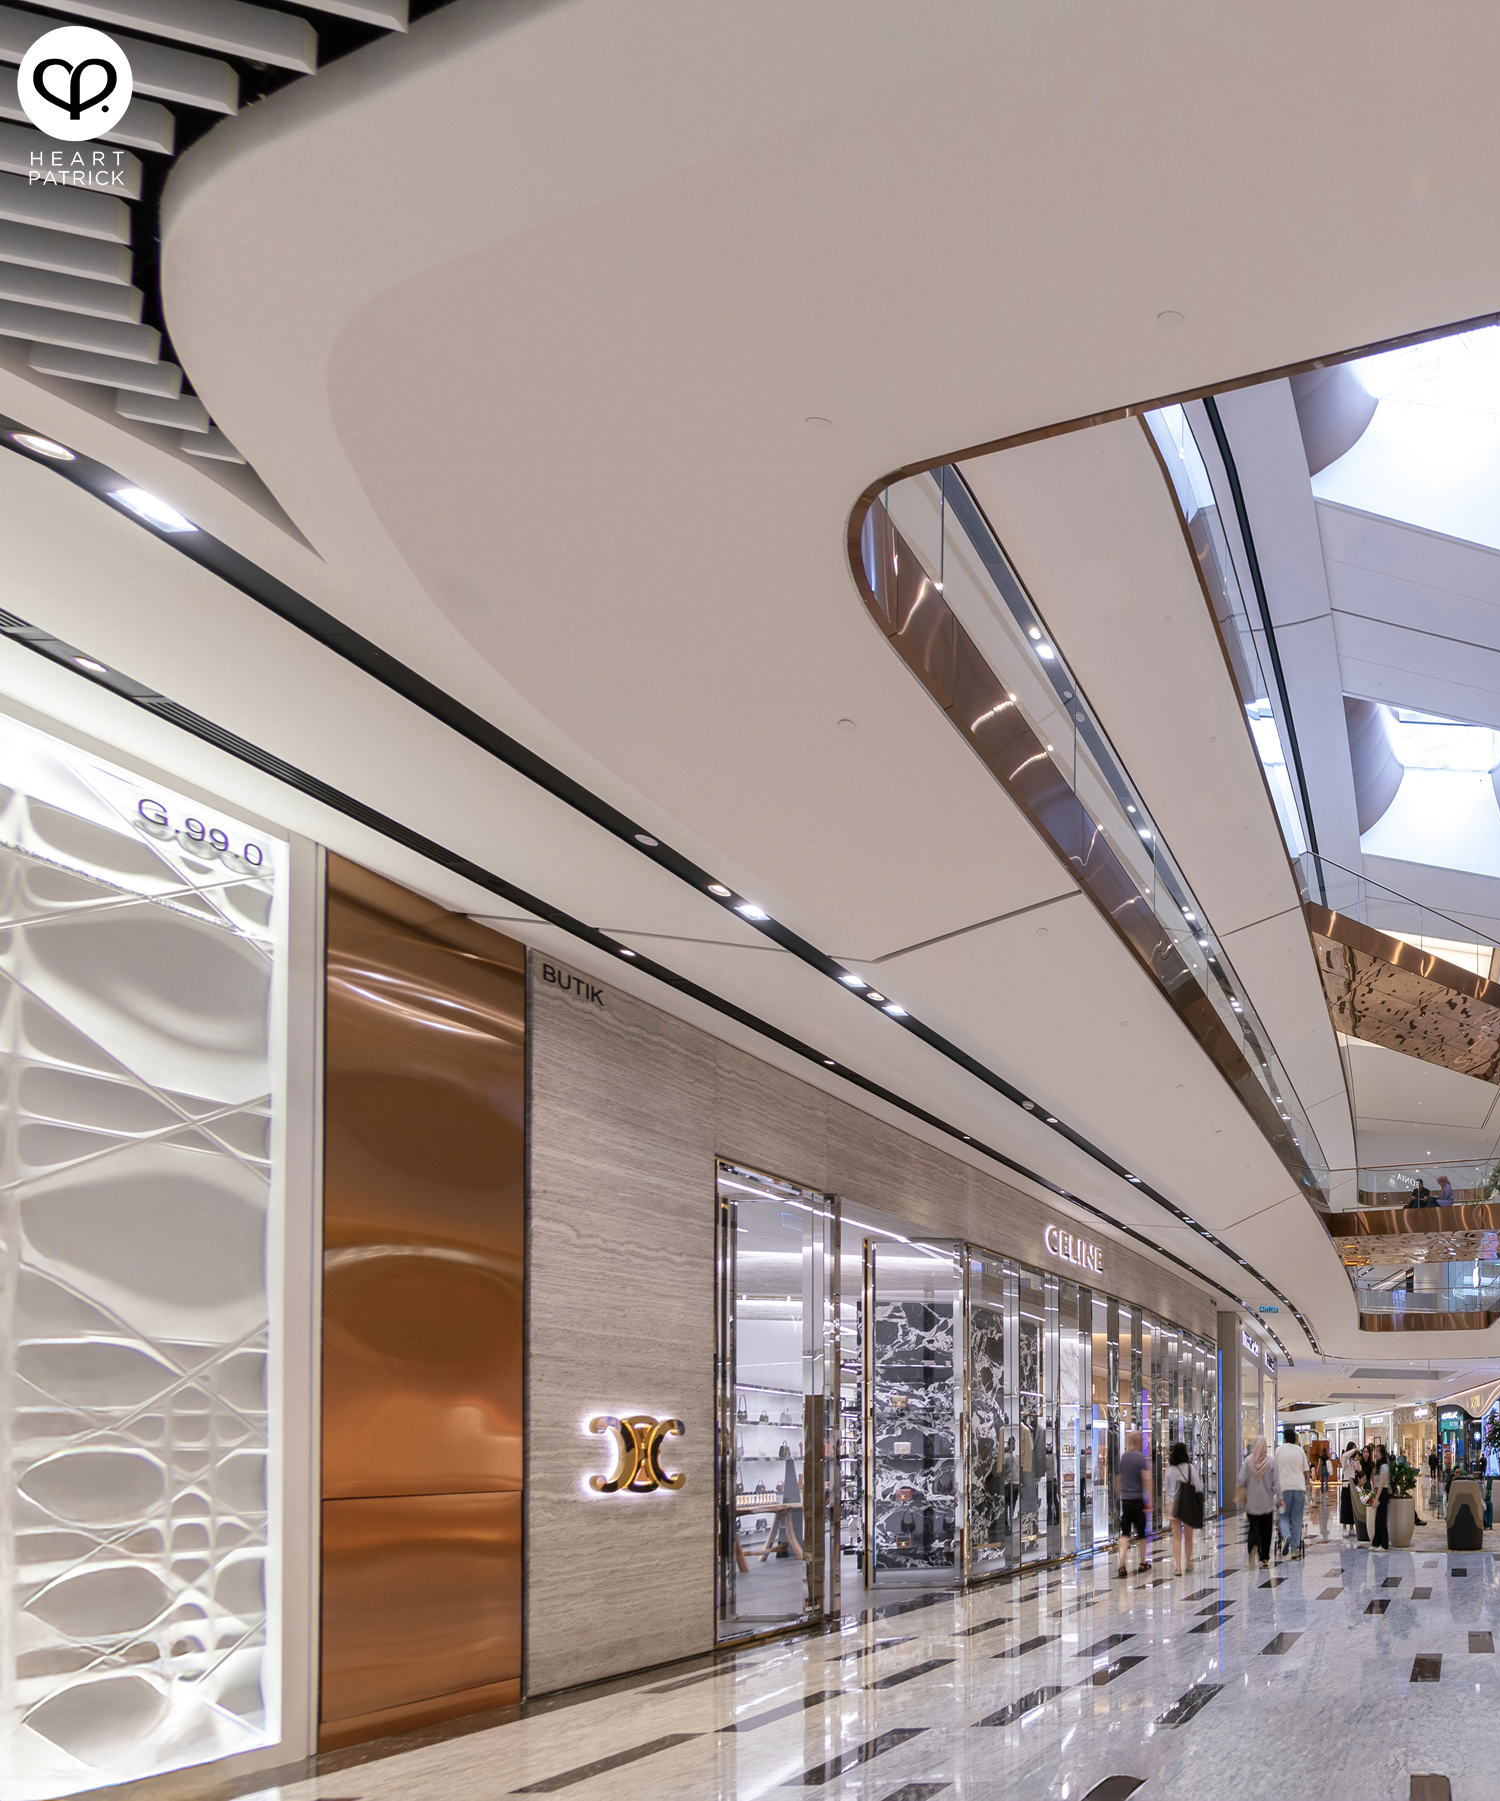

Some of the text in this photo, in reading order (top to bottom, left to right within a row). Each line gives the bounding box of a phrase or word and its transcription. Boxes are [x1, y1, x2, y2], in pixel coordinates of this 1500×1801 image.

[138, 798, 263, 866] G.99.0
[543, 962, 604, 1007] BUTIK
[1045, 1224, 1104, 1275] CELINE
